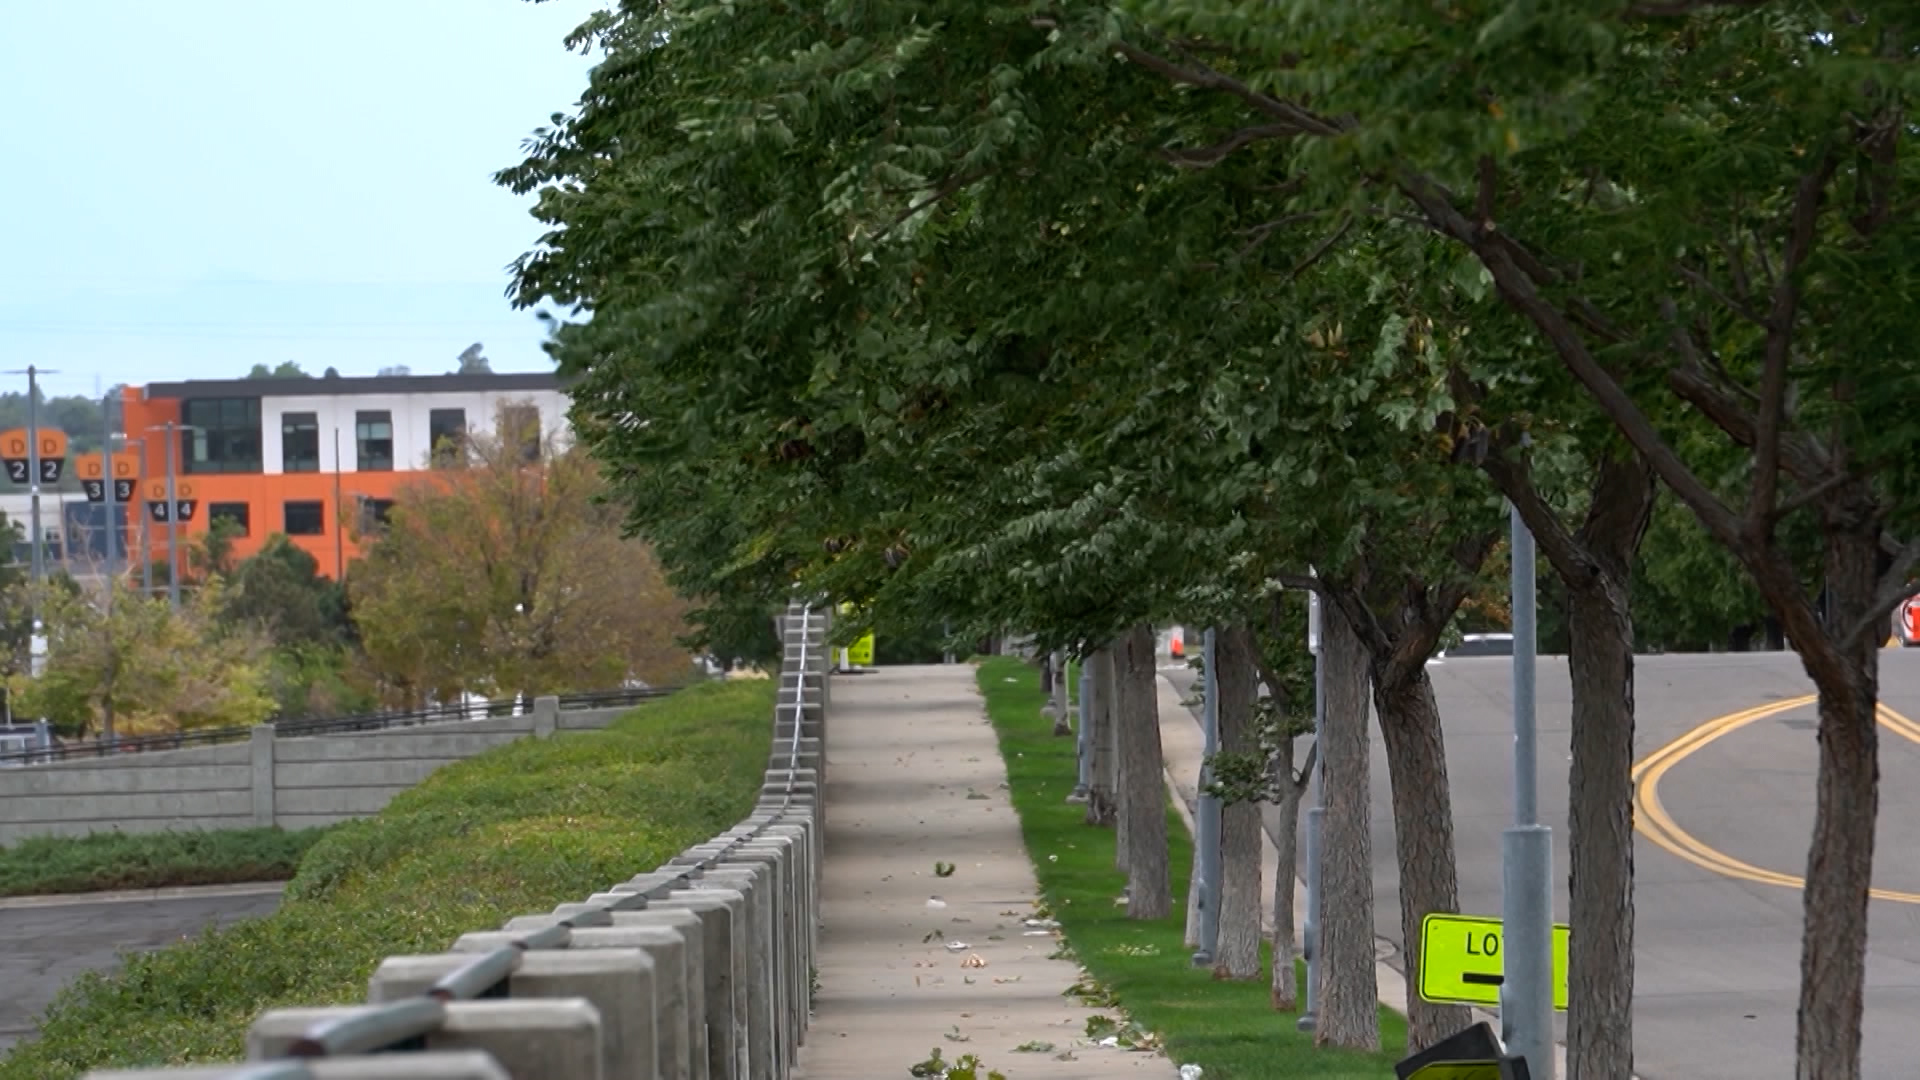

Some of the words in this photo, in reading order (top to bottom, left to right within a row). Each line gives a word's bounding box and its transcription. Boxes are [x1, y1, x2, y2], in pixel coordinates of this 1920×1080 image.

[11, 439, 25, 453] D
[43, 439, 57, 453] D
[12, 461, 25, 478] 2
[45, 461, 57, 478] 2
[87, 462, 100, 476] D
[117, 461, 130, 474] D
[89, 482, 101, 497] 3
[119, 482, 130, 497] 3
[154, 503, 165, 517] 4
[180, 502, 191, 516] 4
[1466, 931, 1504, 956] LO
